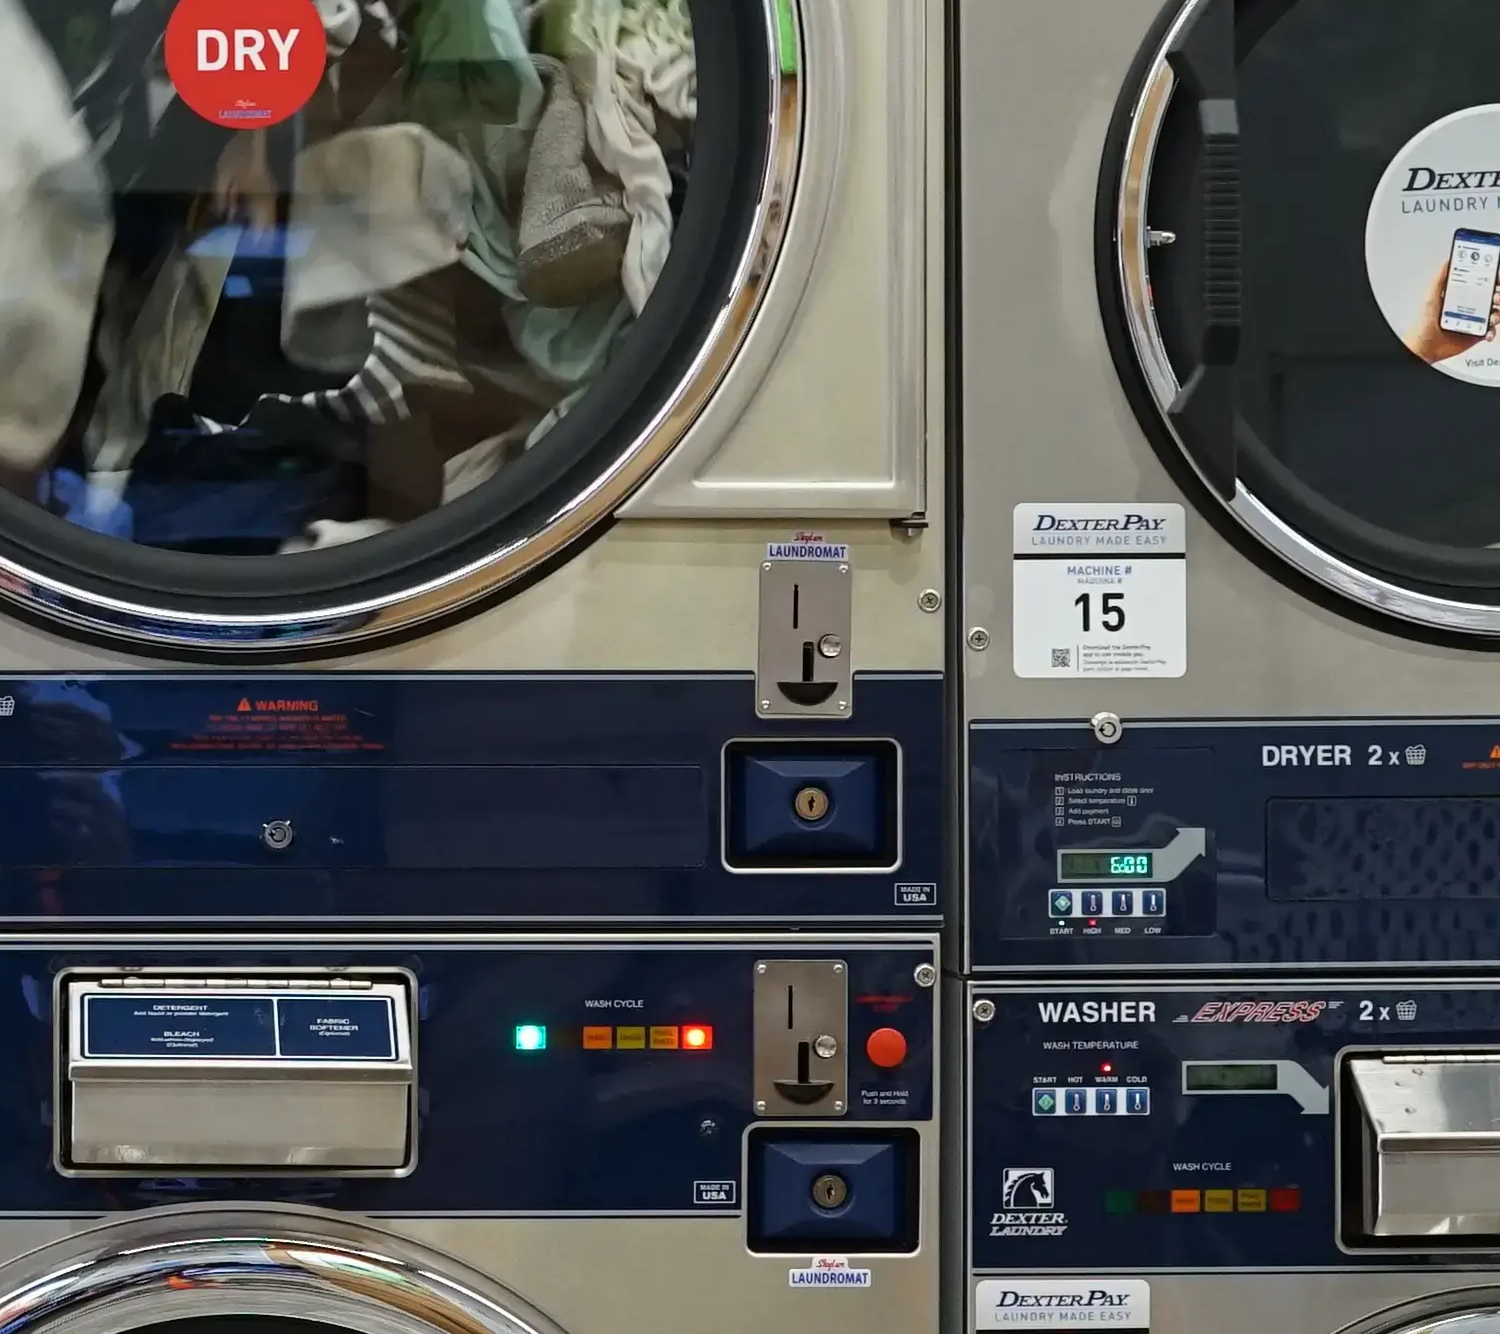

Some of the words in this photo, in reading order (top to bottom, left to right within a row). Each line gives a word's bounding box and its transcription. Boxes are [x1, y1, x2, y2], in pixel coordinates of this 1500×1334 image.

[198, 29, 299, 70] DRY
[1402, 196, 1489, 214] LAUNDRY
[1465, 358, 1485, 367] Visit
[769, 545, 847, 558] LAUNDROMAT
[1075, 593, 1125, 631] 15
[1263, 745, 1351, 766] DRYER
[585, 999, 612, 1008] WASH
[614, 999, 644, 1008] CYCLE
[1039, 1002, 1155, 1022] WASHER
[791, 1272, 868, 1286] LAUNDROMAT
